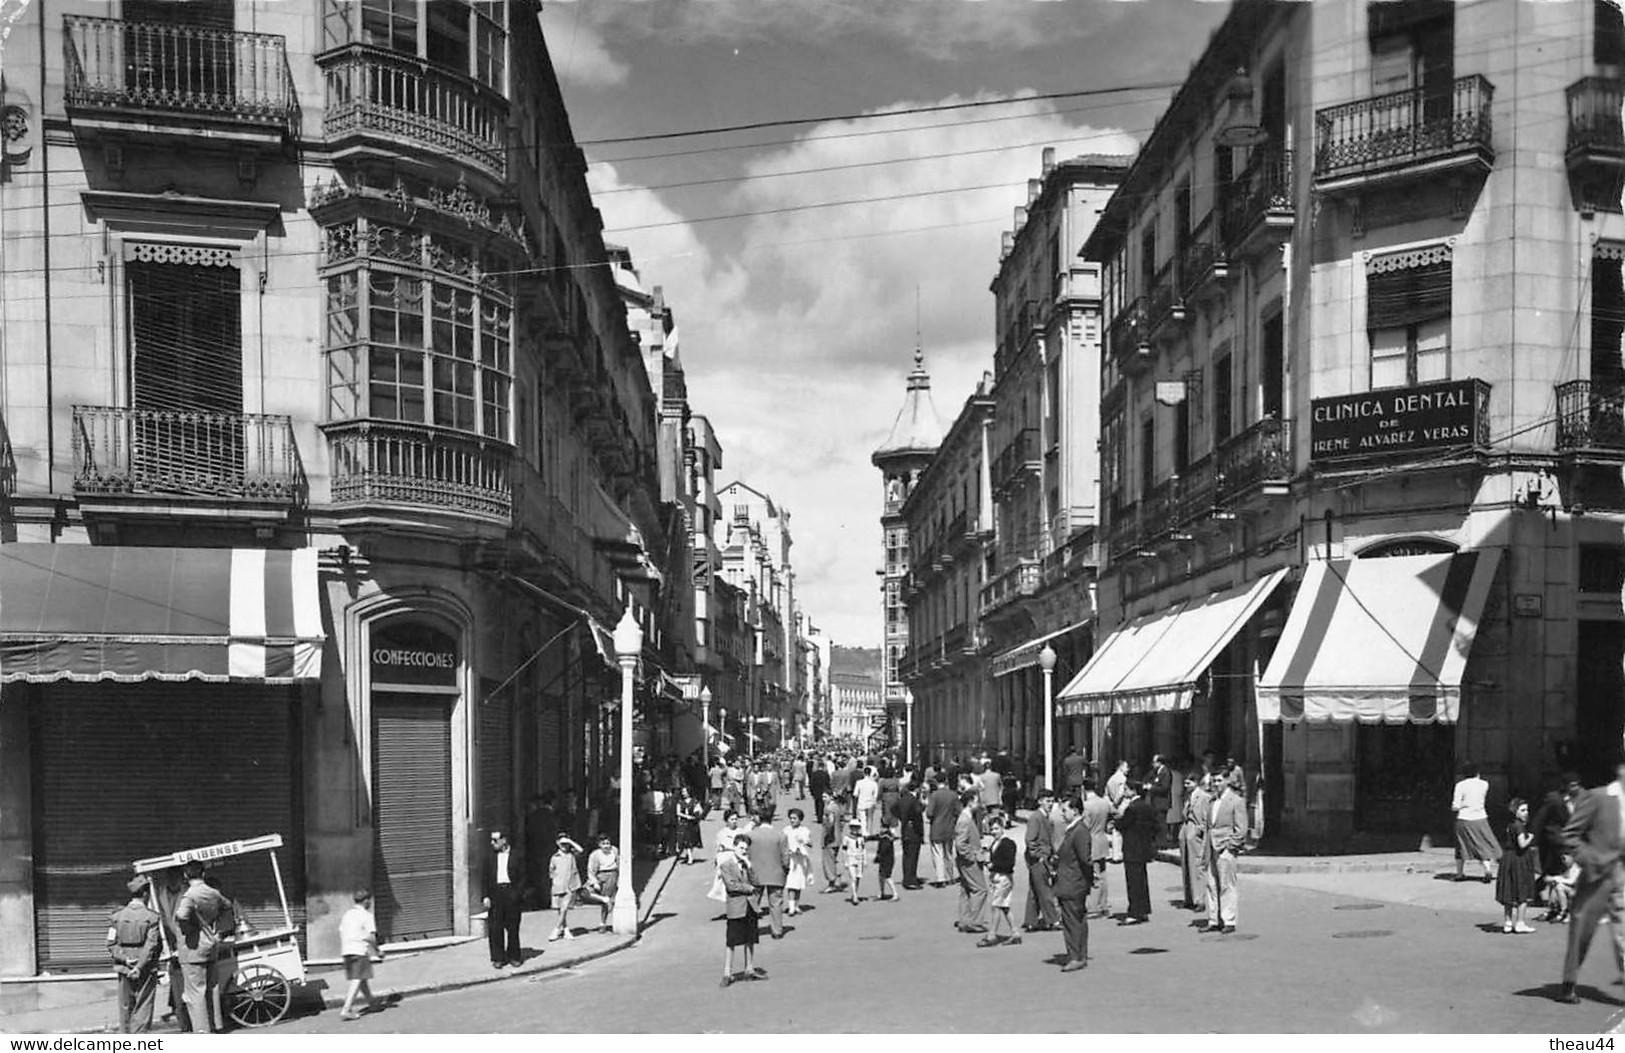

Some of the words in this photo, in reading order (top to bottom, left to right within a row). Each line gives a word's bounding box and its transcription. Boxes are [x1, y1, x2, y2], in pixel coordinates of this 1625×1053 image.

[1314, 400, 1383, 422] CLINICA
[1394, 389, 1470, 414] DENTAL
[1379, 419, 1400, 428] DE
[1314, 437, 1350, 453] IRENE
[1359, 430, 1415, 447] ALVAREZ
[1423, 424, 1469, 440] VERAS
[372, 649, 455, 668] CONFECCIONES
[178, 853, 194, 863] LA
